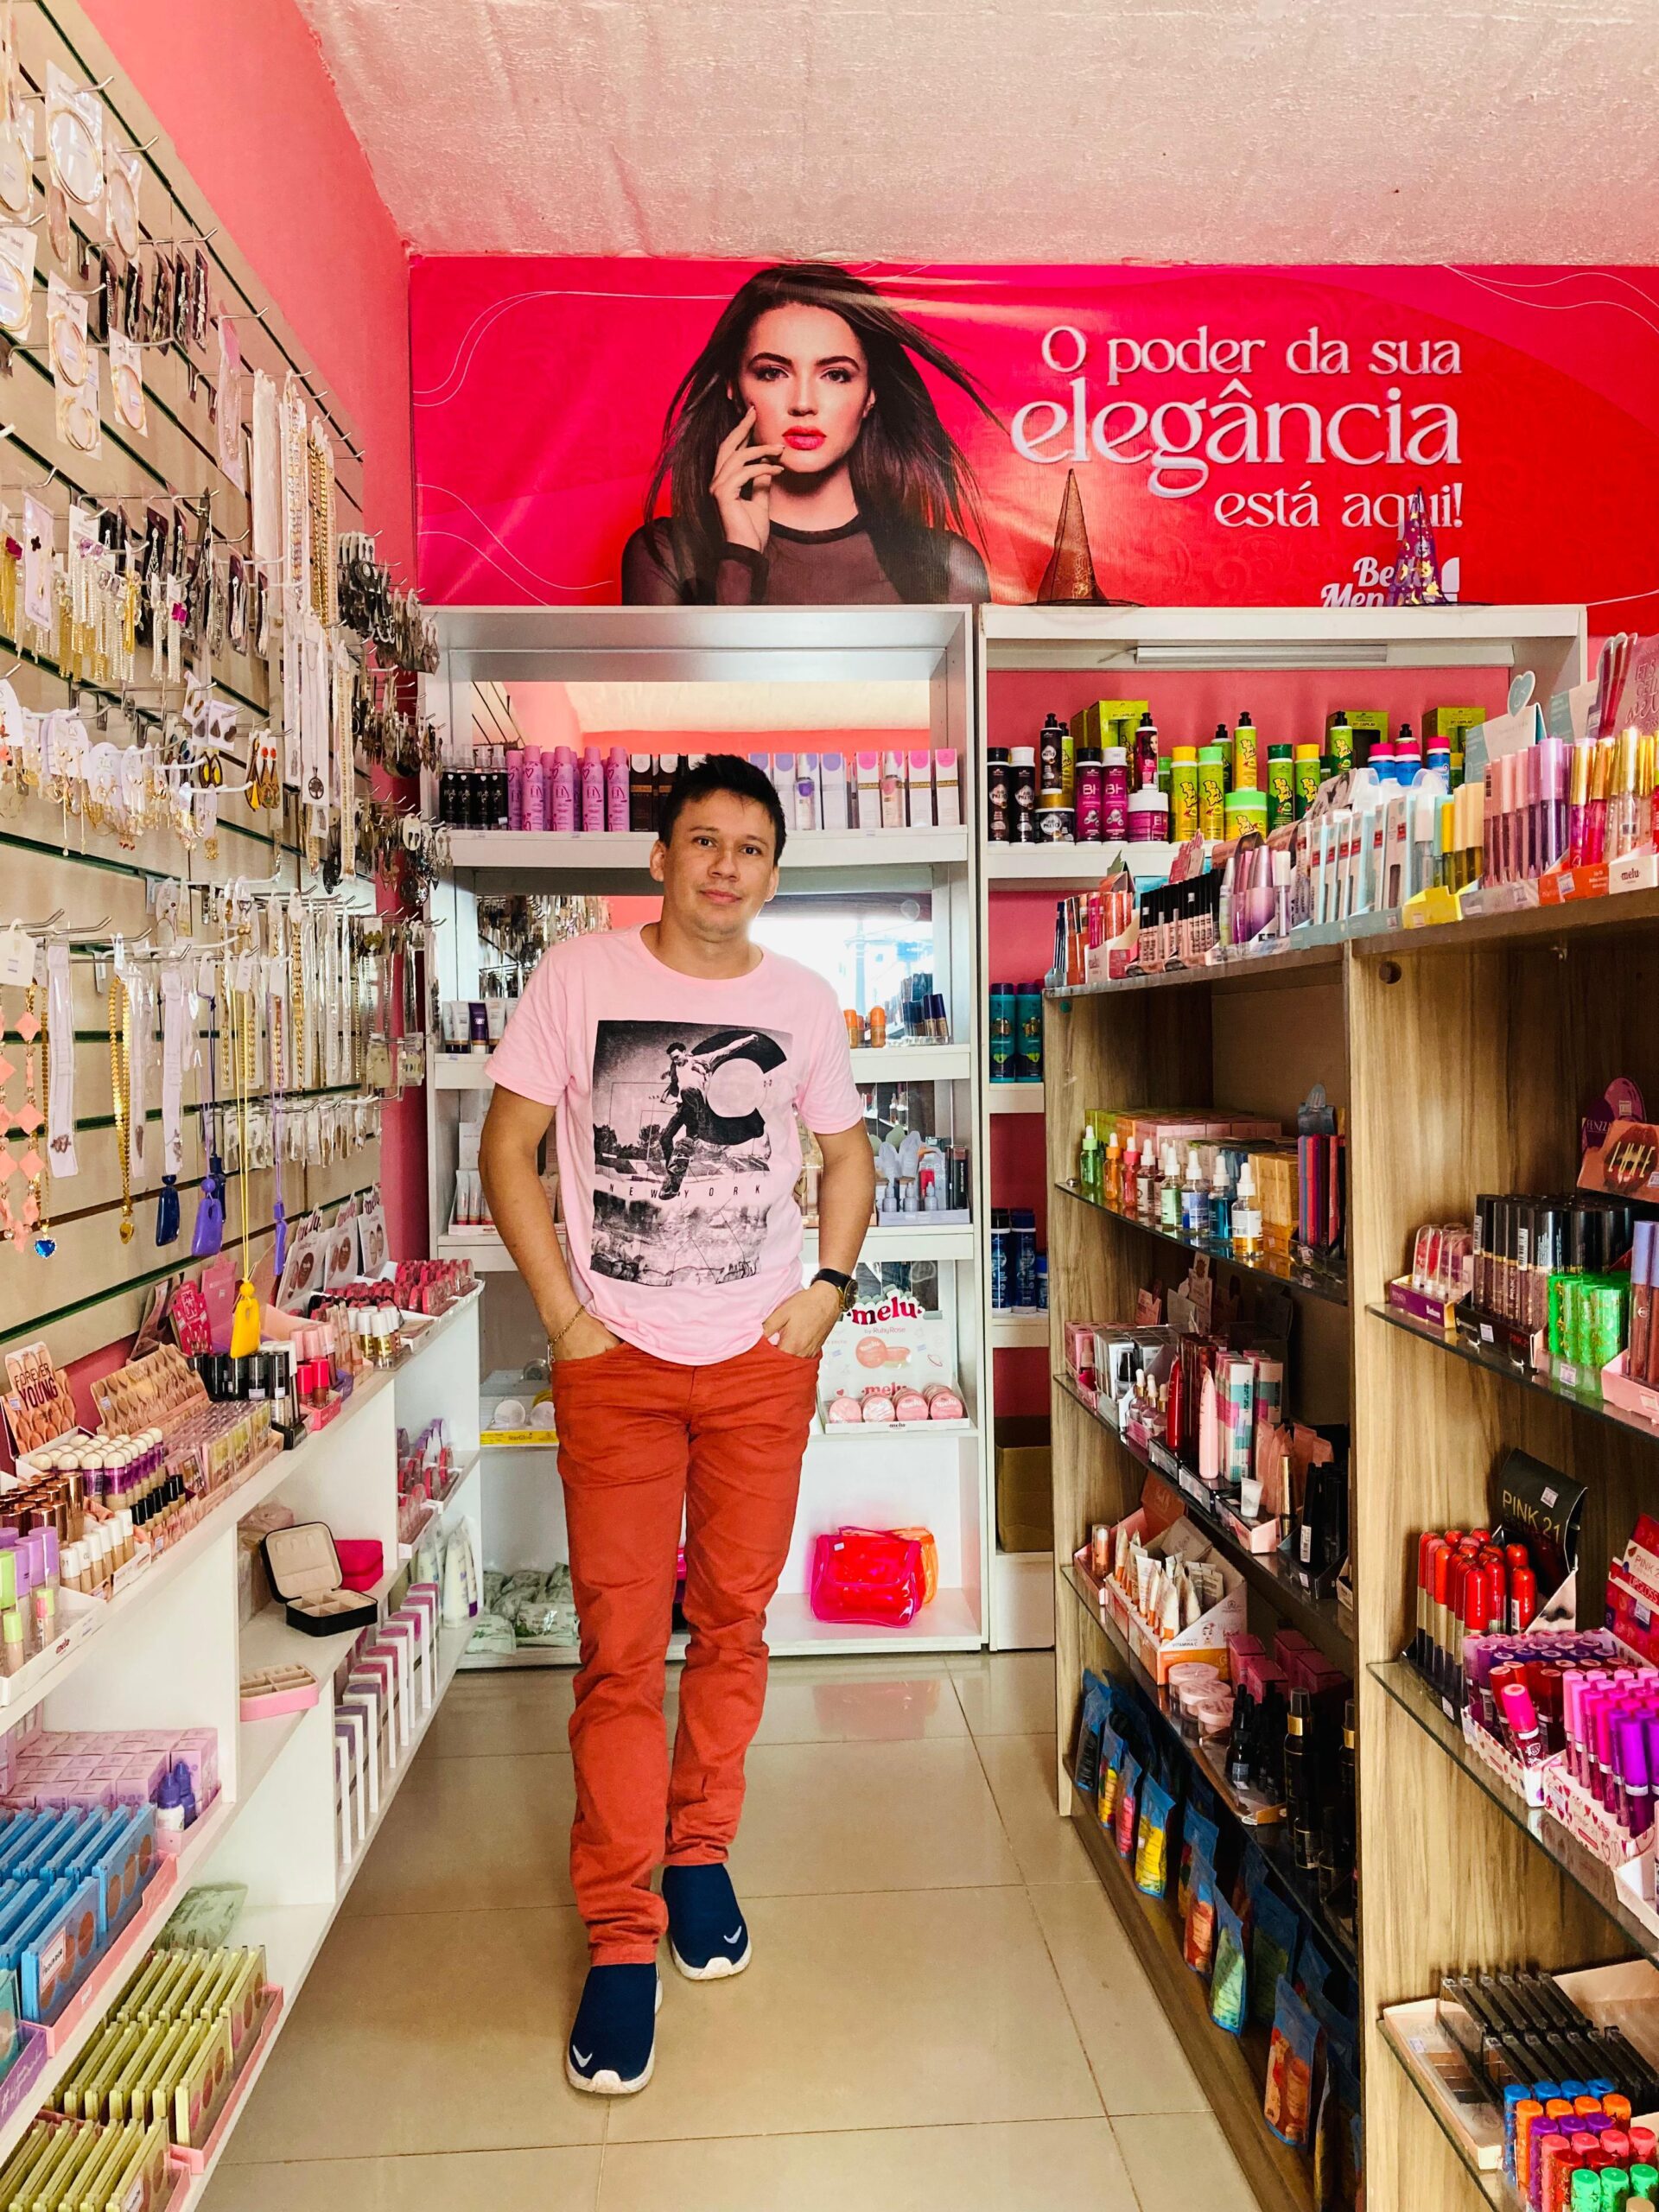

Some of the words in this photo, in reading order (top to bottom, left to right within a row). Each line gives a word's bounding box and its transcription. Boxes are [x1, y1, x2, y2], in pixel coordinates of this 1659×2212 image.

[1042, 326, 1086, 372] O
[1108, 326, 1266, 386] poder
[1286, 326, 1351, 374] da
[1368, 340, 1462, 375] sua
[1010, 377, 1462, 498] elegância
[1214, 480, 1320, 527] está
[1622, 868, 1638, 880] melu
[1586, 1119, 1610, 1131] FENZZ
[684, 1184, 760, 1198] YORK
[851, 1297, 918, 1325] melu
[15, 1363, 51, 1386] FOREVER
[19, 1376, 58, 1411] YOUNG
[1503, 1490, 1539, 1530] PINK
[1542, 1516, 1560, 1544] 21
[1635, 1554, 1654, 1573] PINK
